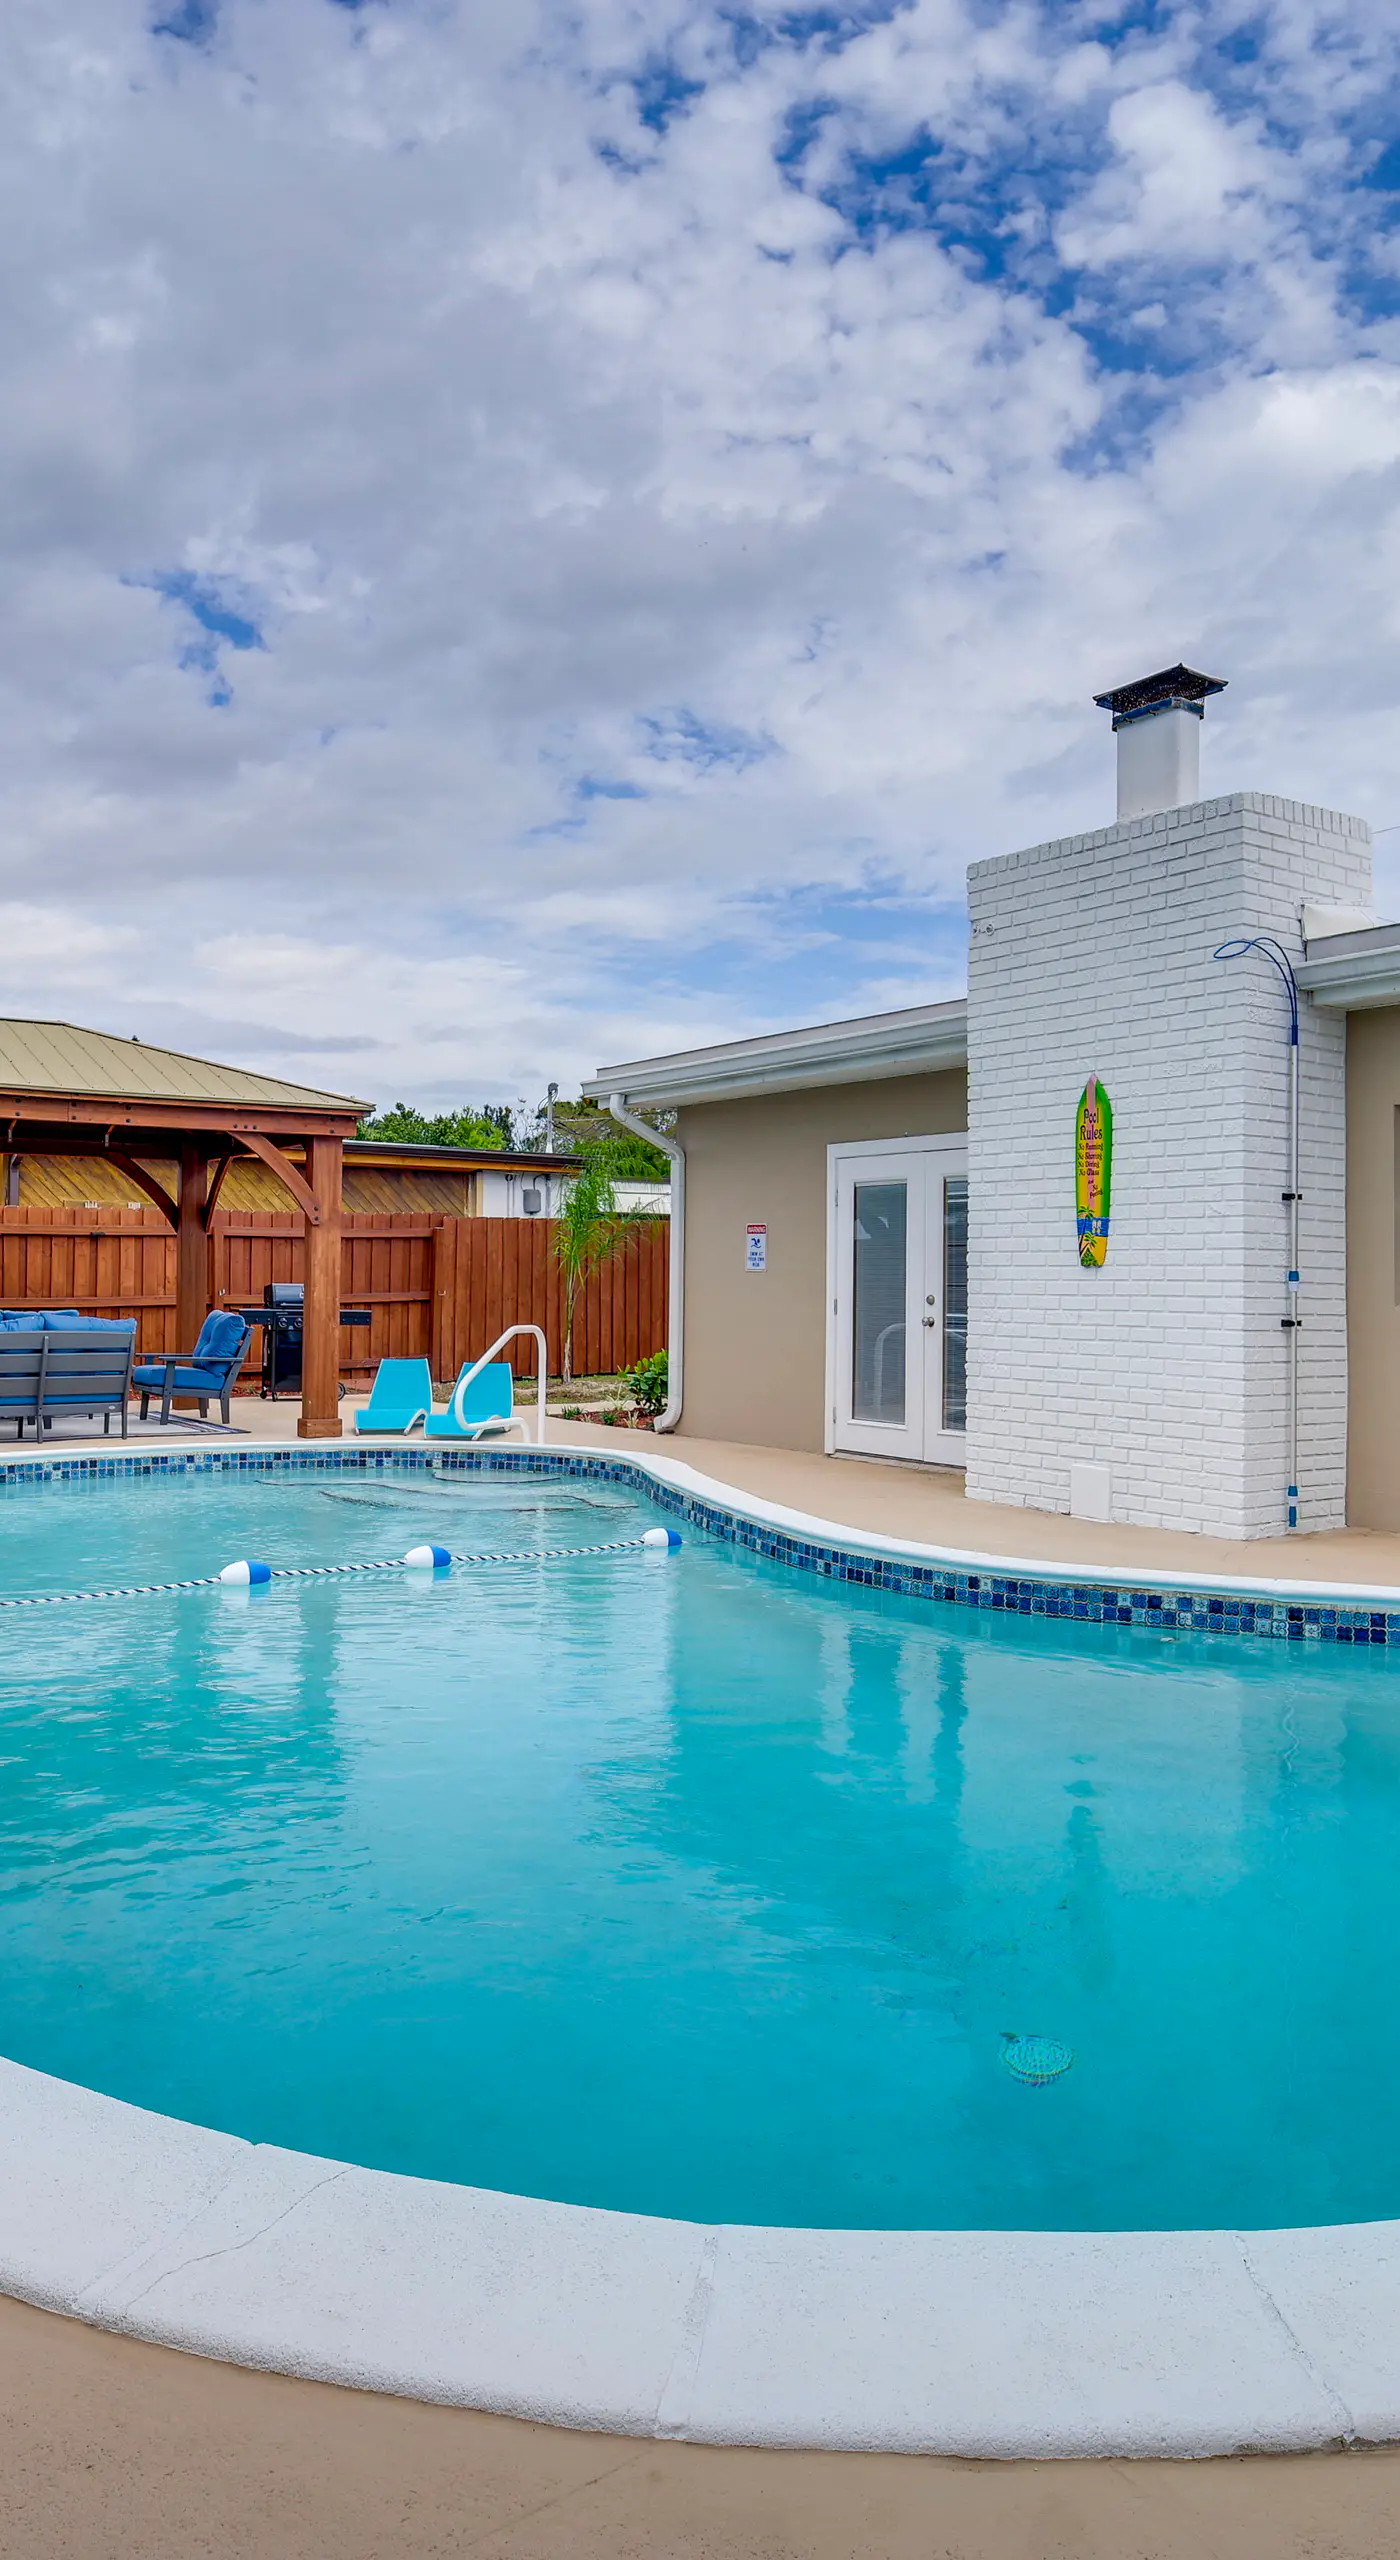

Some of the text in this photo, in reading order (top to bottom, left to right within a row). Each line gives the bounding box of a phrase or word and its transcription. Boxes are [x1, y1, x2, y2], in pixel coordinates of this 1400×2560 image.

[1084, 1108, 1099, 1124] Pool
[1080, 1124, 1103, 1140] Rules
[1086, 1142, 1103, 1151] Running
[1085, 1160, 1100, 1168] Diving
